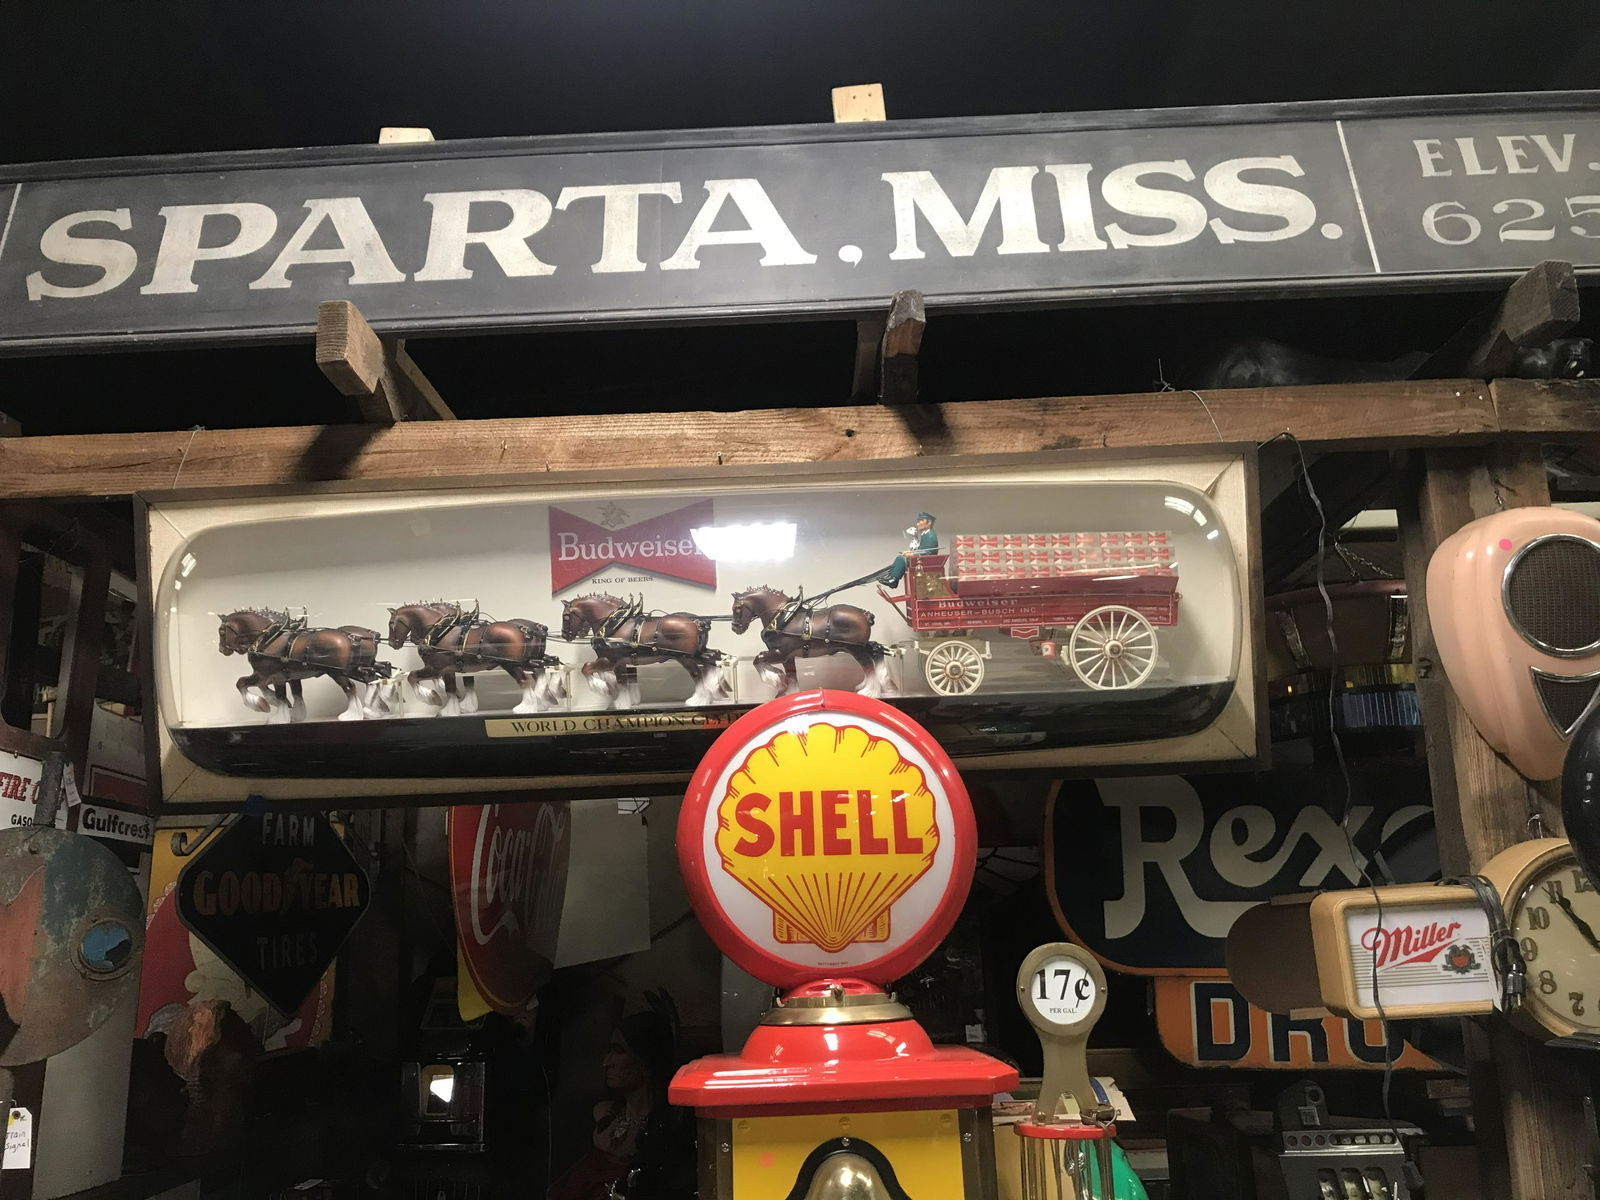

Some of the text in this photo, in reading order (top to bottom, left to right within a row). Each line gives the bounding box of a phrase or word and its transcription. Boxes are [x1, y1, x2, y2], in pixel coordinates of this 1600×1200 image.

[881, 155, 1343, 261] MISS.
[938, 599, 1018, 608] Budweiser
[511, 718, 577, 734] WORLD
[583, 714, 685, 731] CHAMPION
[0, 772, 31, 802] FIRE
[11, 814, 33, 828] GASO
[82, 807, 150, 840] Gulfcrest
[262, 812, 316, 848] FARM
[733, 789, 924, 857] SHELL
[1526, 906, 1550, 930] 10
[256, 931, 319, 969] TIRES
[1361, 922, 1462, 968] Miller
[1520, 937, 1538, 961] 9
[1035, 968, 1091, 1008] 17¢
[1539, 970, 1557, 994] 8
